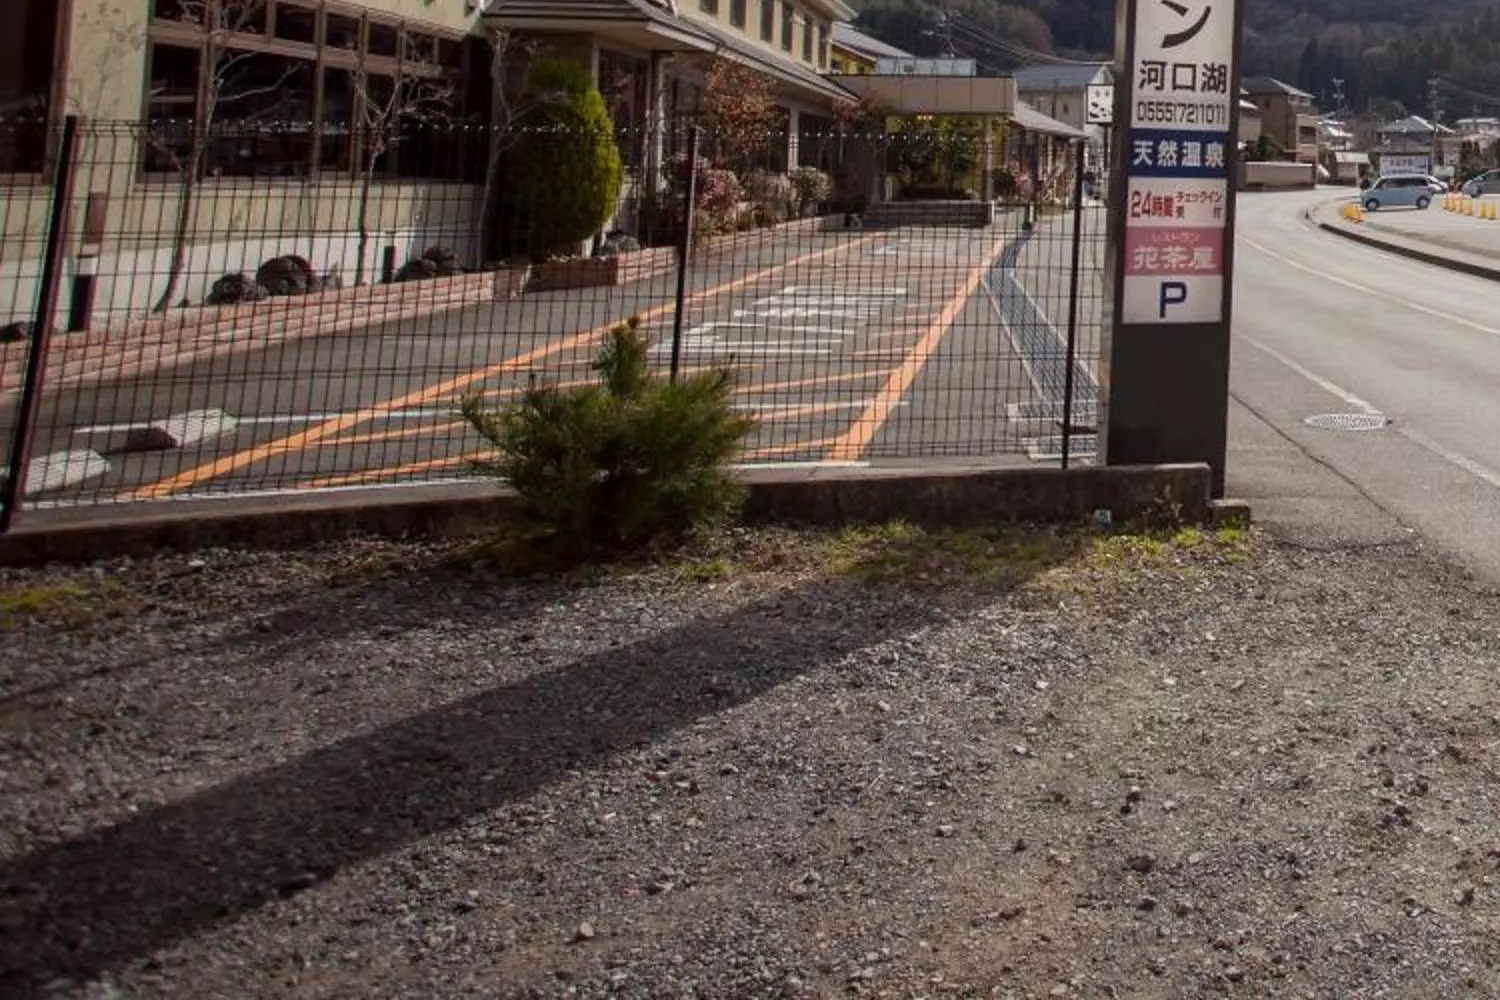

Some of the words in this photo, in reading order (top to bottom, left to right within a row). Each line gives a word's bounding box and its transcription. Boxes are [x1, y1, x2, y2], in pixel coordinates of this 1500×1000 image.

[1139, 60, 1227, 95] 河口湖
[1132, 139, 1225, 168] 天然温泉
[1131, 190, 1174, 218] 24時間
[1151, 231, 1200, 243] レストラン
[1159, 281, 1187, 319] P
